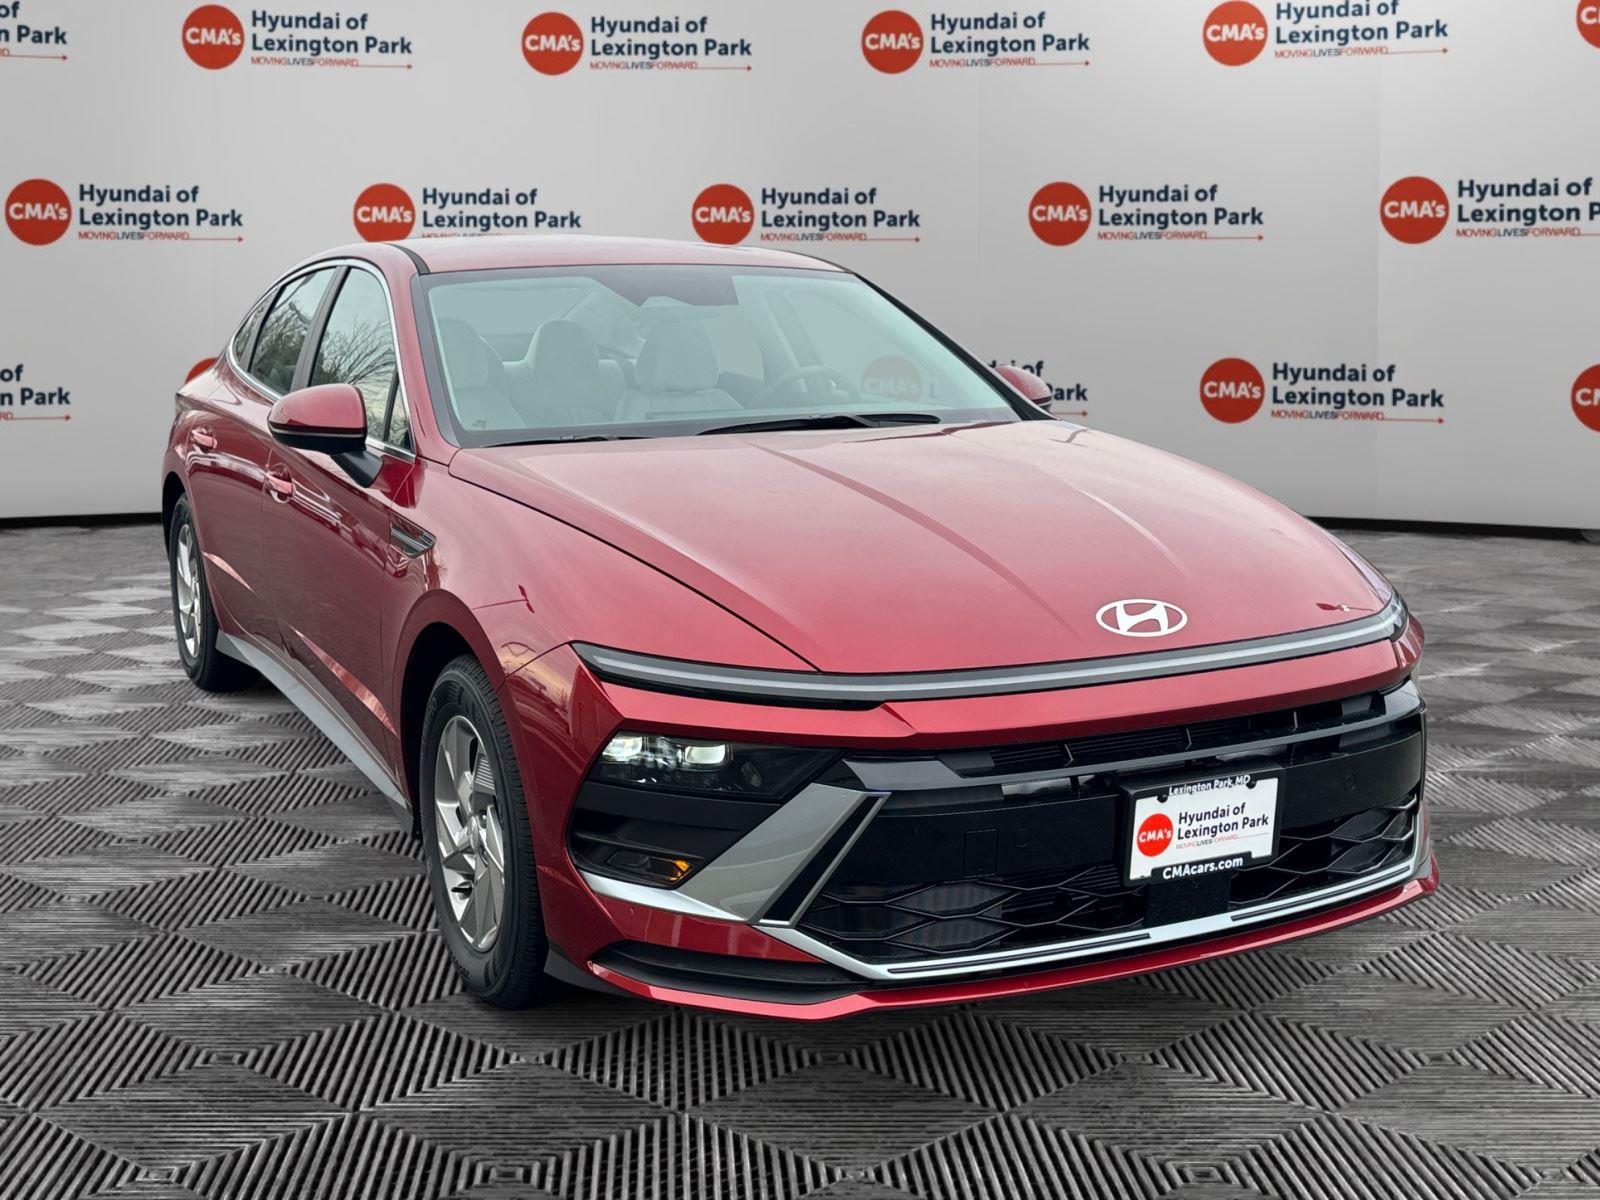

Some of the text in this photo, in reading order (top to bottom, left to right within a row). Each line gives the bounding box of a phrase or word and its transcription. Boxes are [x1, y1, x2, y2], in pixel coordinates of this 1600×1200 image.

[251, 10, 368, 32] Hyundai of
[1276, 0, 1399, 24] Hyundai of
[591, 17, 707, 37] Hyundai of
[931, 12, 1045, 34] Hyundai of
[1206, 24, 1265, 42] CMA's
[1276, 20, 1448, 46] Lexington Park
[17, 24, 67, 44] Park
[185, 27, 241, 45] CMA's
[525, 35, 581, 51] CMA's
[865, 34, 921, 50] CMA's
[251, 34, 412, 55] Lexington Park
[591, 39, 752, 59] Lexington Park
[931, 34, 1090, 56] Lexington Park
[79, 184, 199, 206] Hyundai of
[422, 188, 537, 208] Hyundai of
[761, 188, 877, 209] Hyundai of
[1099, 184, 1217, 207] Hyundai of
[1458, 177, 1592, 202] Hyundai of
[9, 203, 68, 220] CMA's
[79, 208, 243, 230] Lexington Park
[357, 206, 412, 223] CMA's
[695, 207, 751, 223] CMA's
[1032, 205, 1088, 222] CMA's
[1099, 207, 1263, 229] Lexington Park
[1384, 201, 1445, 219] CMA's
[1458, 204, 1580, 226] Lexington
[422, 211, 581, 231] Lexington Park
[761, 210, 920, 231] Lexington Park
[0, 363, 24, 382] of
[1272, 363, 1396, 385] Hyundai of
[20, 386, 70, 405] Park
[1204, 381, 1261, 398] CMA's
[1272, 387, 1444, 409] Lexington Park
[1169, 781, 1212, 795] Lexington
[1235, 775, 1250, 784] MD
[1179, 802, 1246, 826] Hyundai of
[1139, 829, 1172, 843] CMA's
[1178, 814, 1268, 840] Lexington Park
[1163, 857, 1243, 879] CMAcars.com
